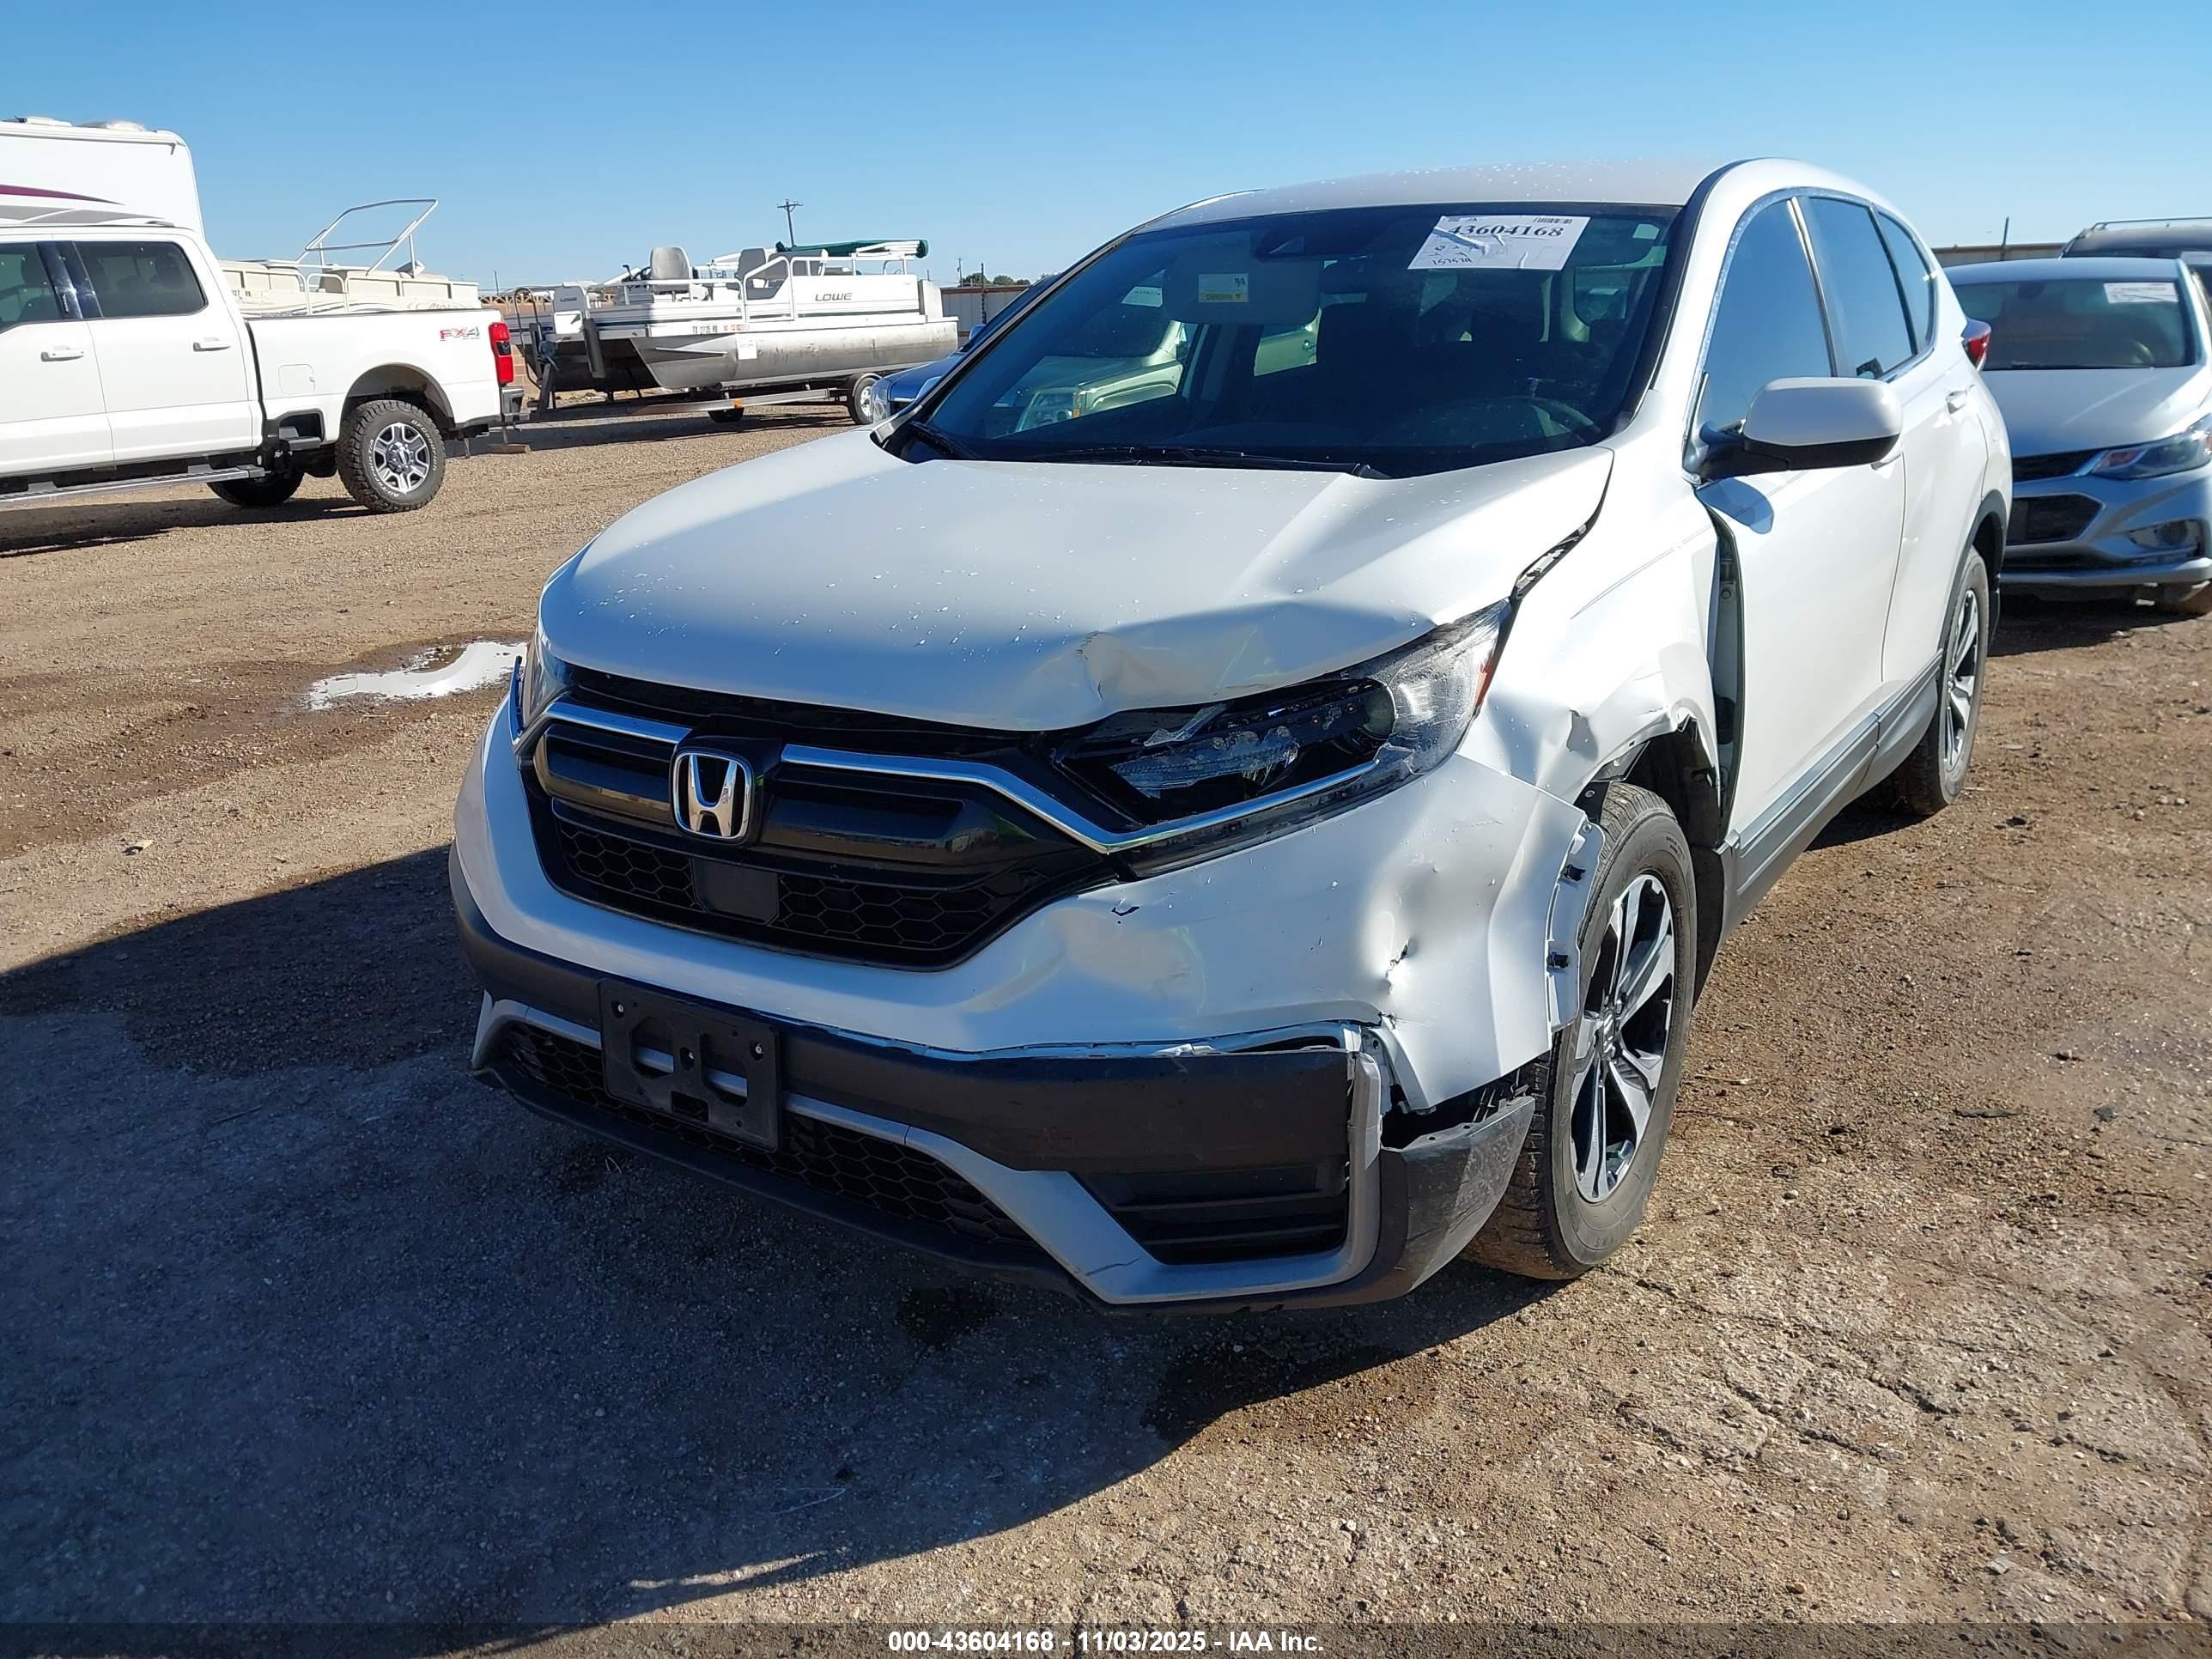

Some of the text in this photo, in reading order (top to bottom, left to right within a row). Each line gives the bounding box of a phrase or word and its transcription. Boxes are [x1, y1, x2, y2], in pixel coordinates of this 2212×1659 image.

[1448, 224, 1564, 237] 43604168
[815, 292, 853, 301] LOWE
[440, 326, 480, 339] FX4
